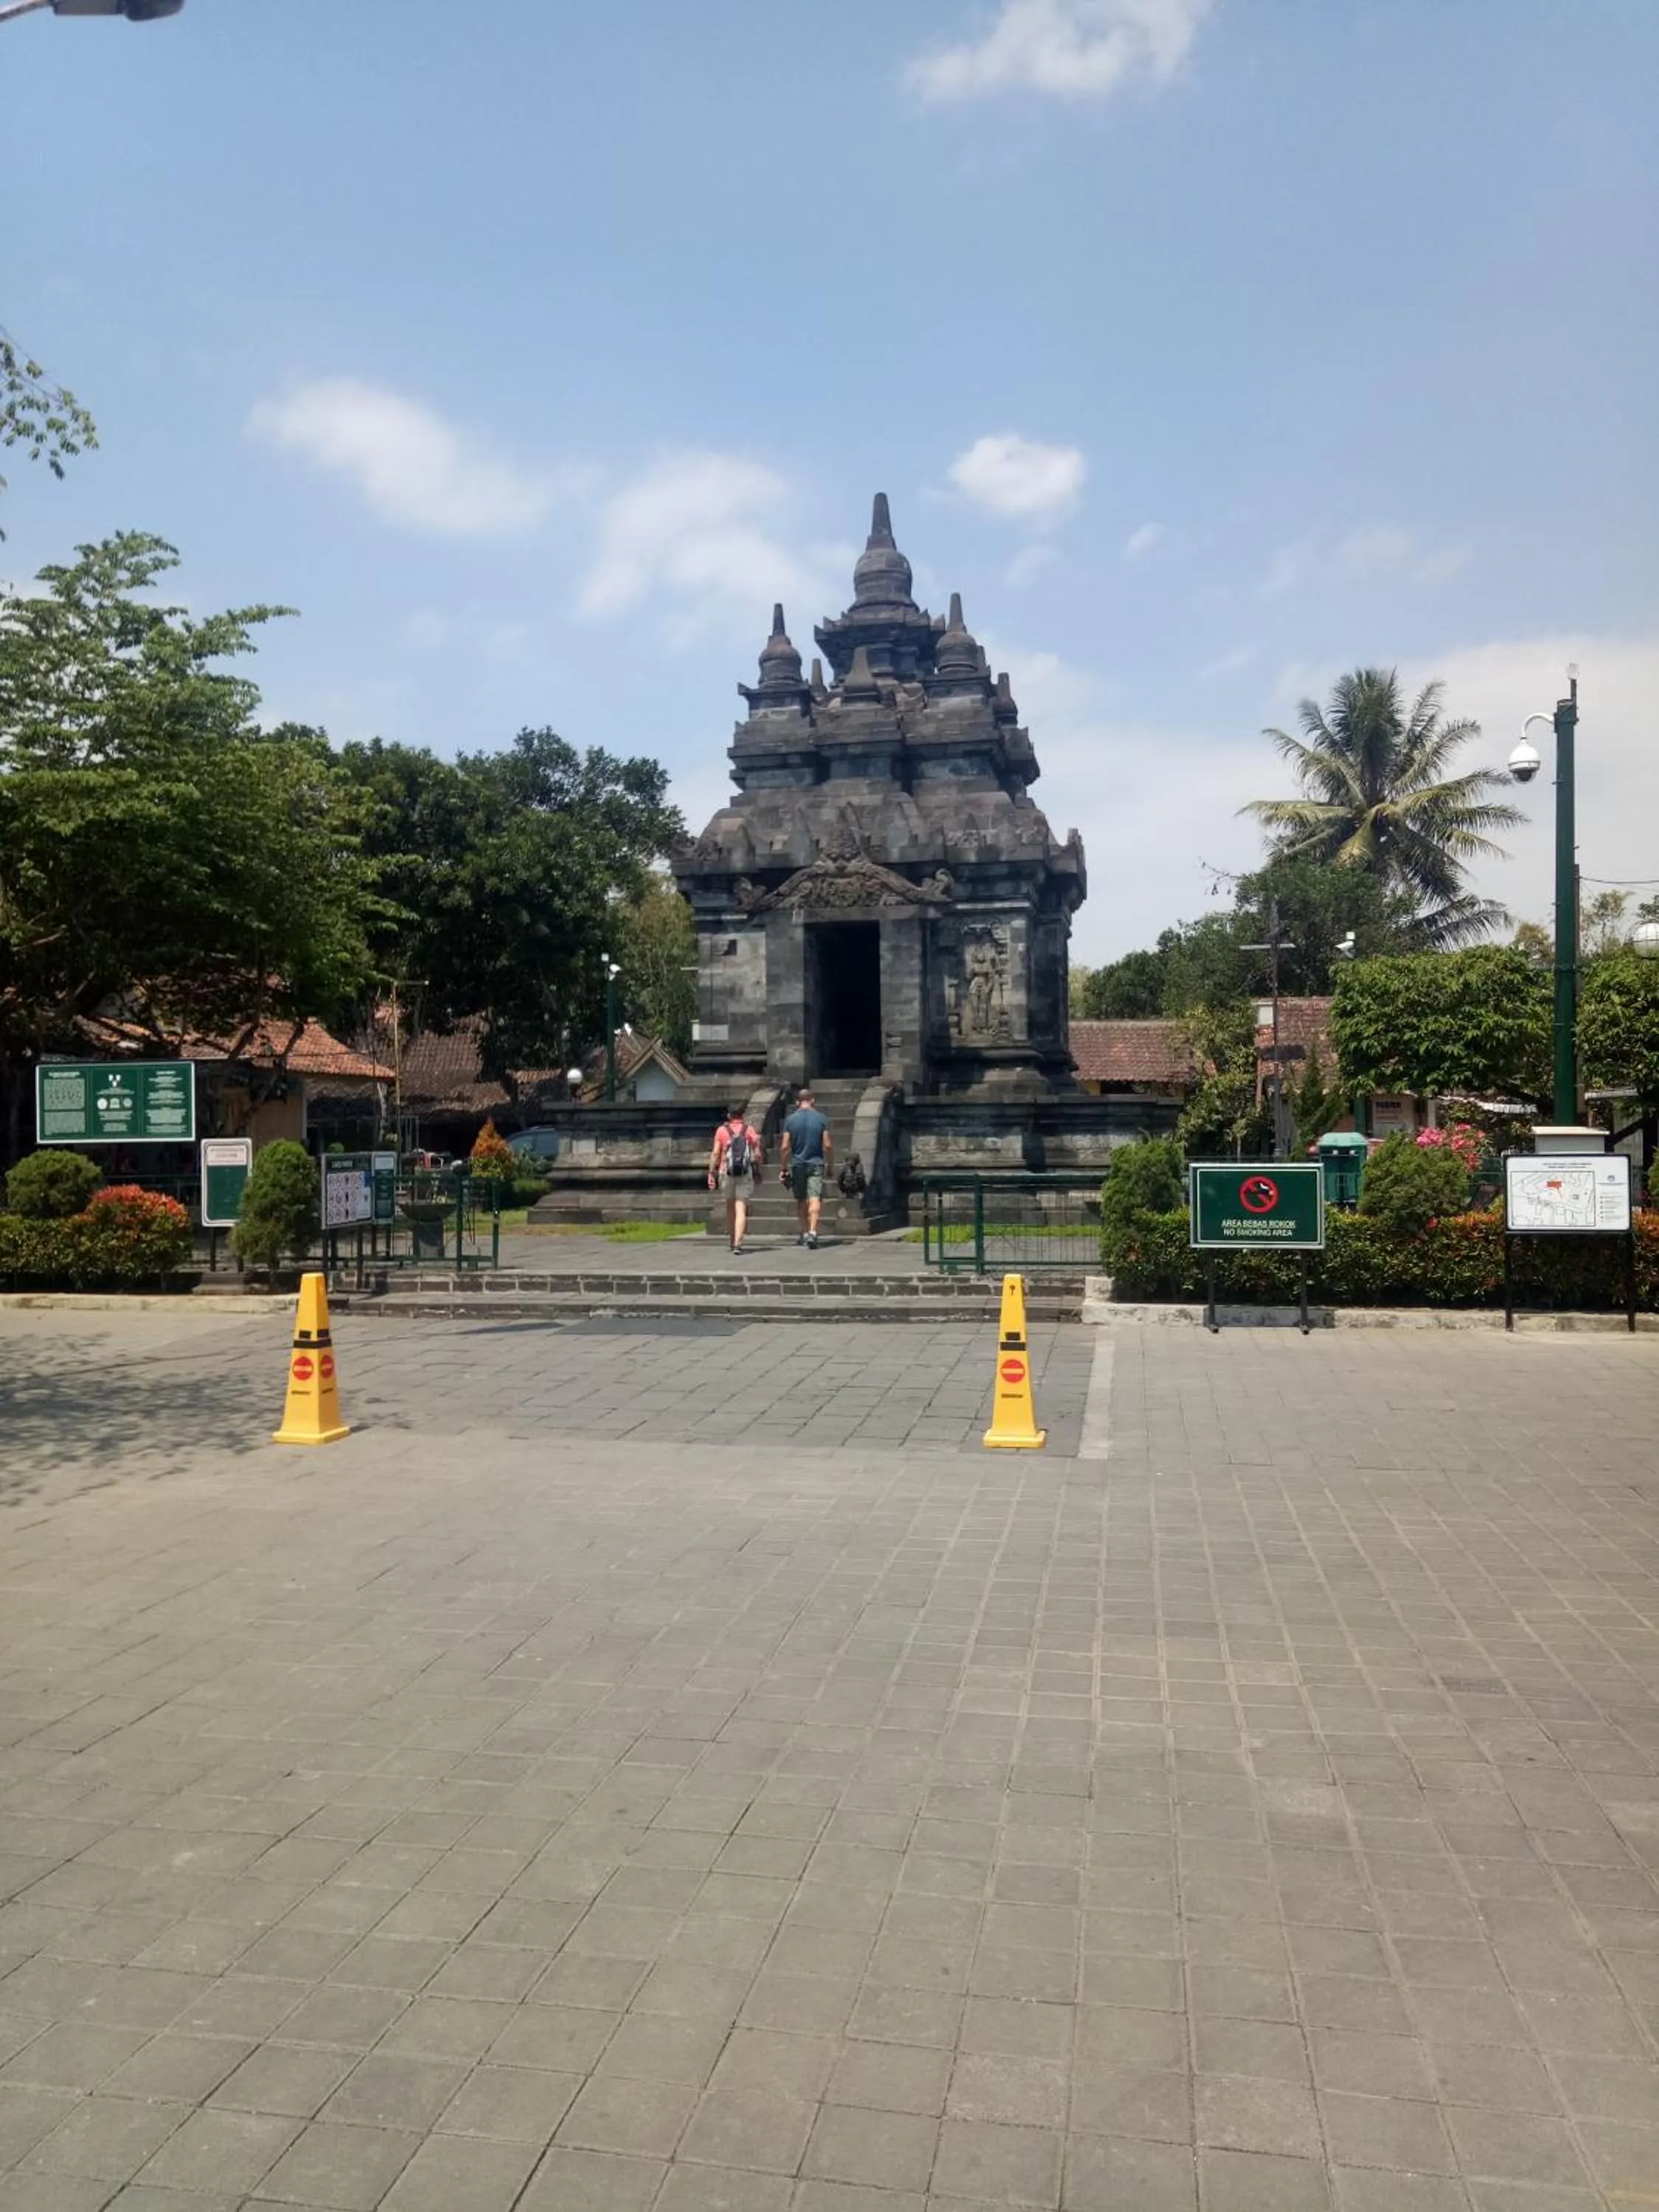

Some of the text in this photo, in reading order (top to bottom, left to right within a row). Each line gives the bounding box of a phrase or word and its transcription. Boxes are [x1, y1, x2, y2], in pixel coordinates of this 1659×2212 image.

[1222, 1219, 1242, 1228] AREA
[1224, 1228, 1293, 1237] NO SMOKING AREA
